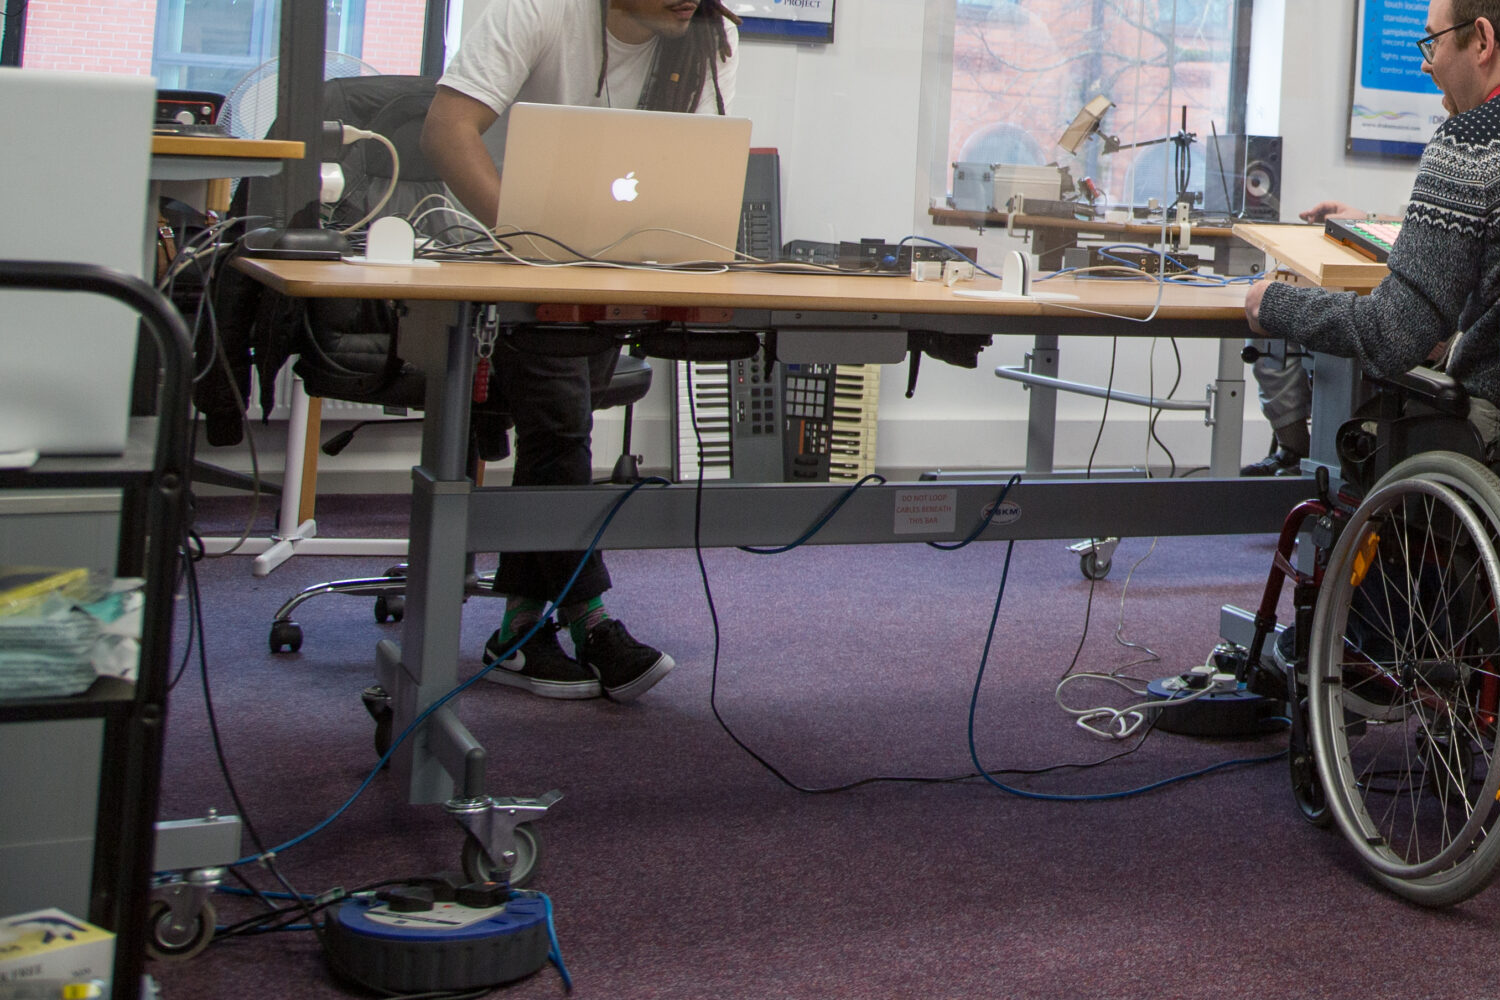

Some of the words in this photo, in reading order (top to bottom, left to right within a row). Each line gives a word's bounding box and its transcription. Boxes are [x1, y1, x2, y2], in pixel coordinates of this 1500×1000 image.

[1383, 0, 1403, 9] touch
[921, 505, 952, 513] BENEATH
[924, 516, 938, 524] BAR
